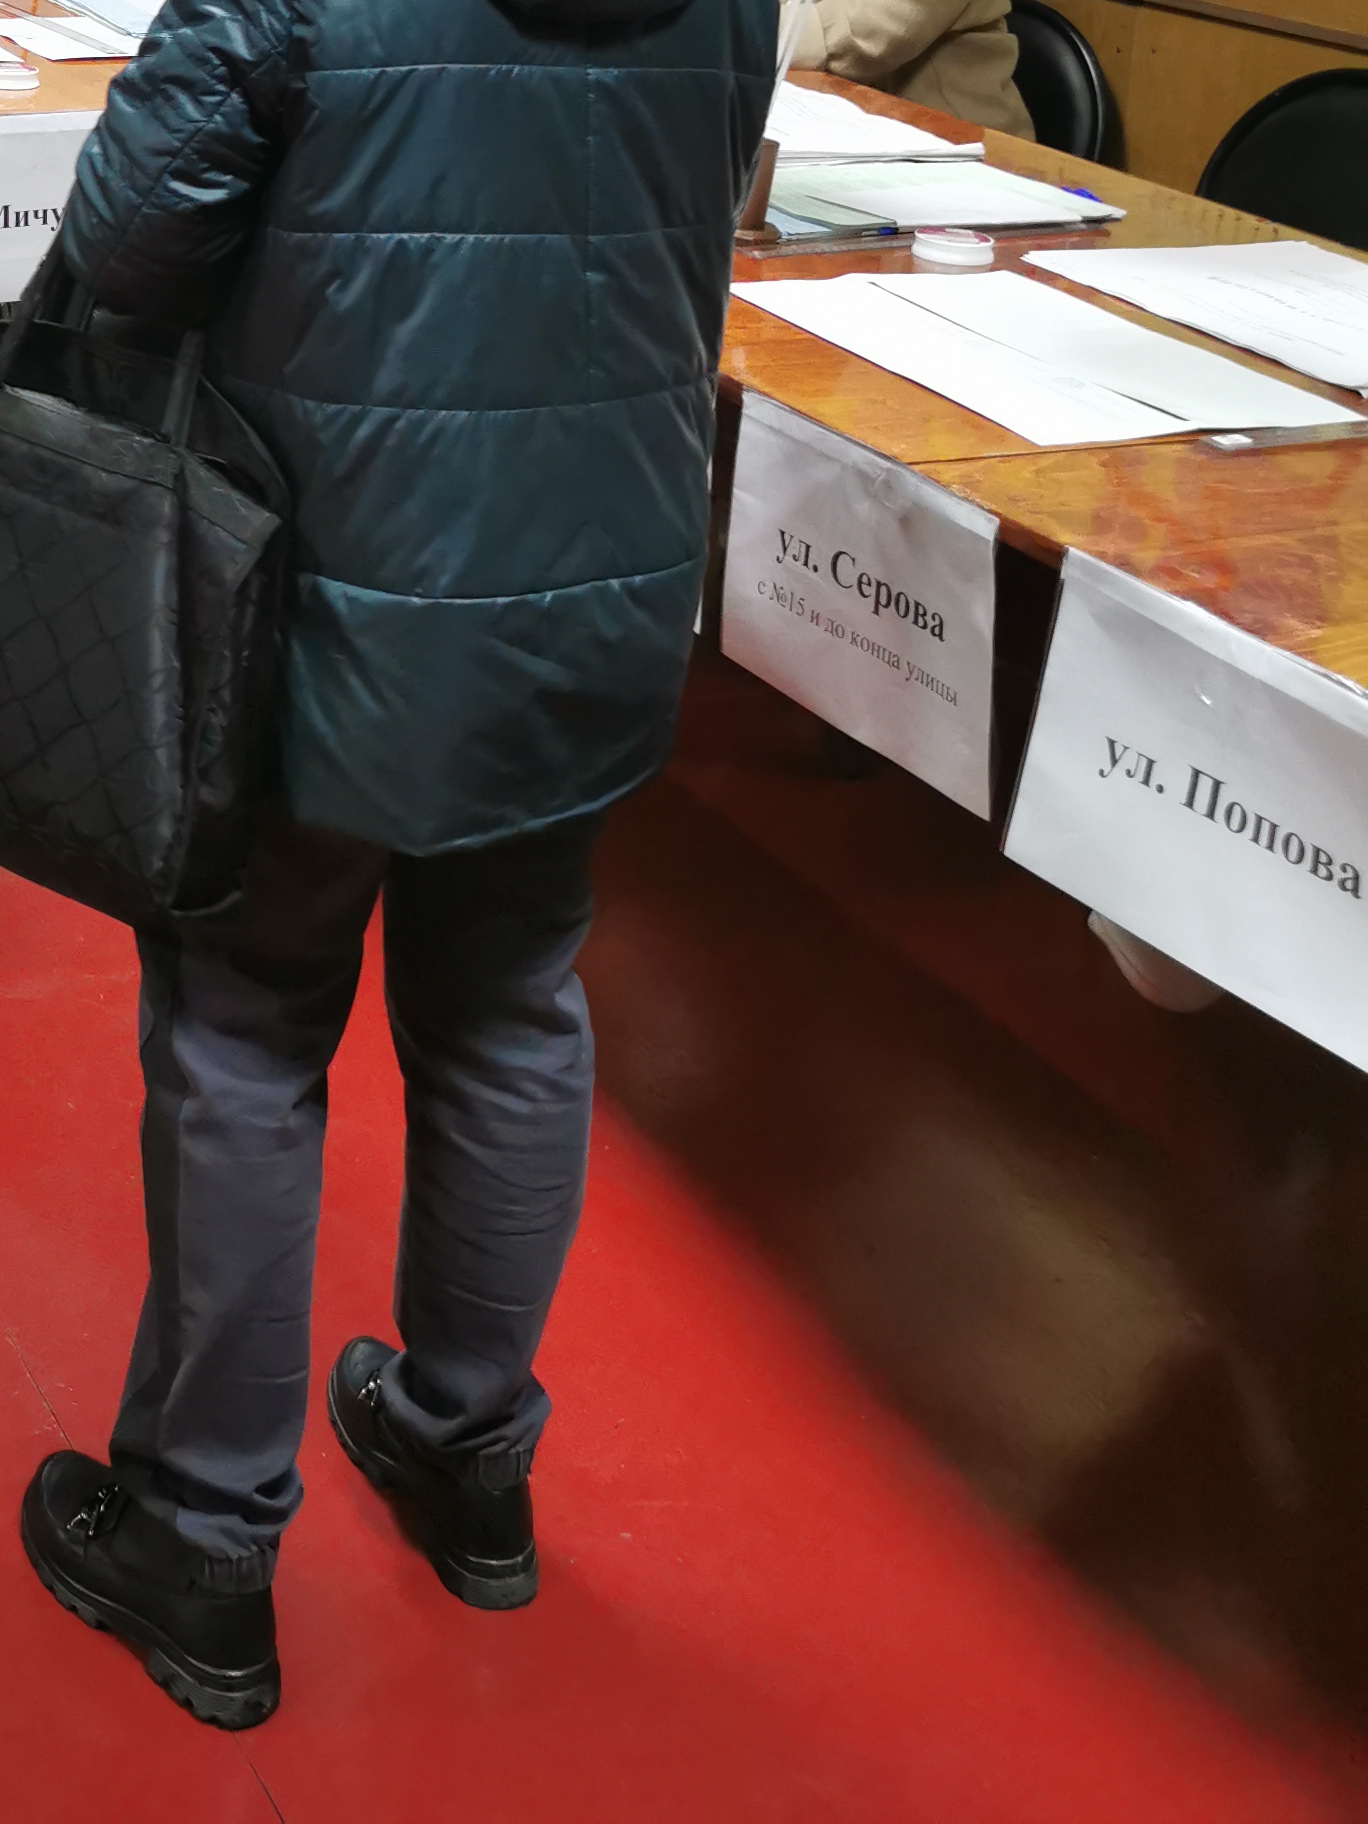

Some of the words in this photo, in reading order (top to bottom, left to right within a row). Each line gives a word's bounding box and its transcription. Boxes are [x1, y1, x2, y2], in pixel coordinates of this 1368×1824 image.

[757, 581, 766, 596] с
[768, 581, 806, 617] №15
[810, 608, 821, 627] и
[824, 618, 846, 640] до
[849, 631, 902, 672] конца
[904, 656, 959, 707] улицы
[776, 528, 818, 573] ул.
[830, 550, 946, 642] Серова
[1098, 736, 1164, 795] ул.
[1180, 763, 1362, 900] Попова
